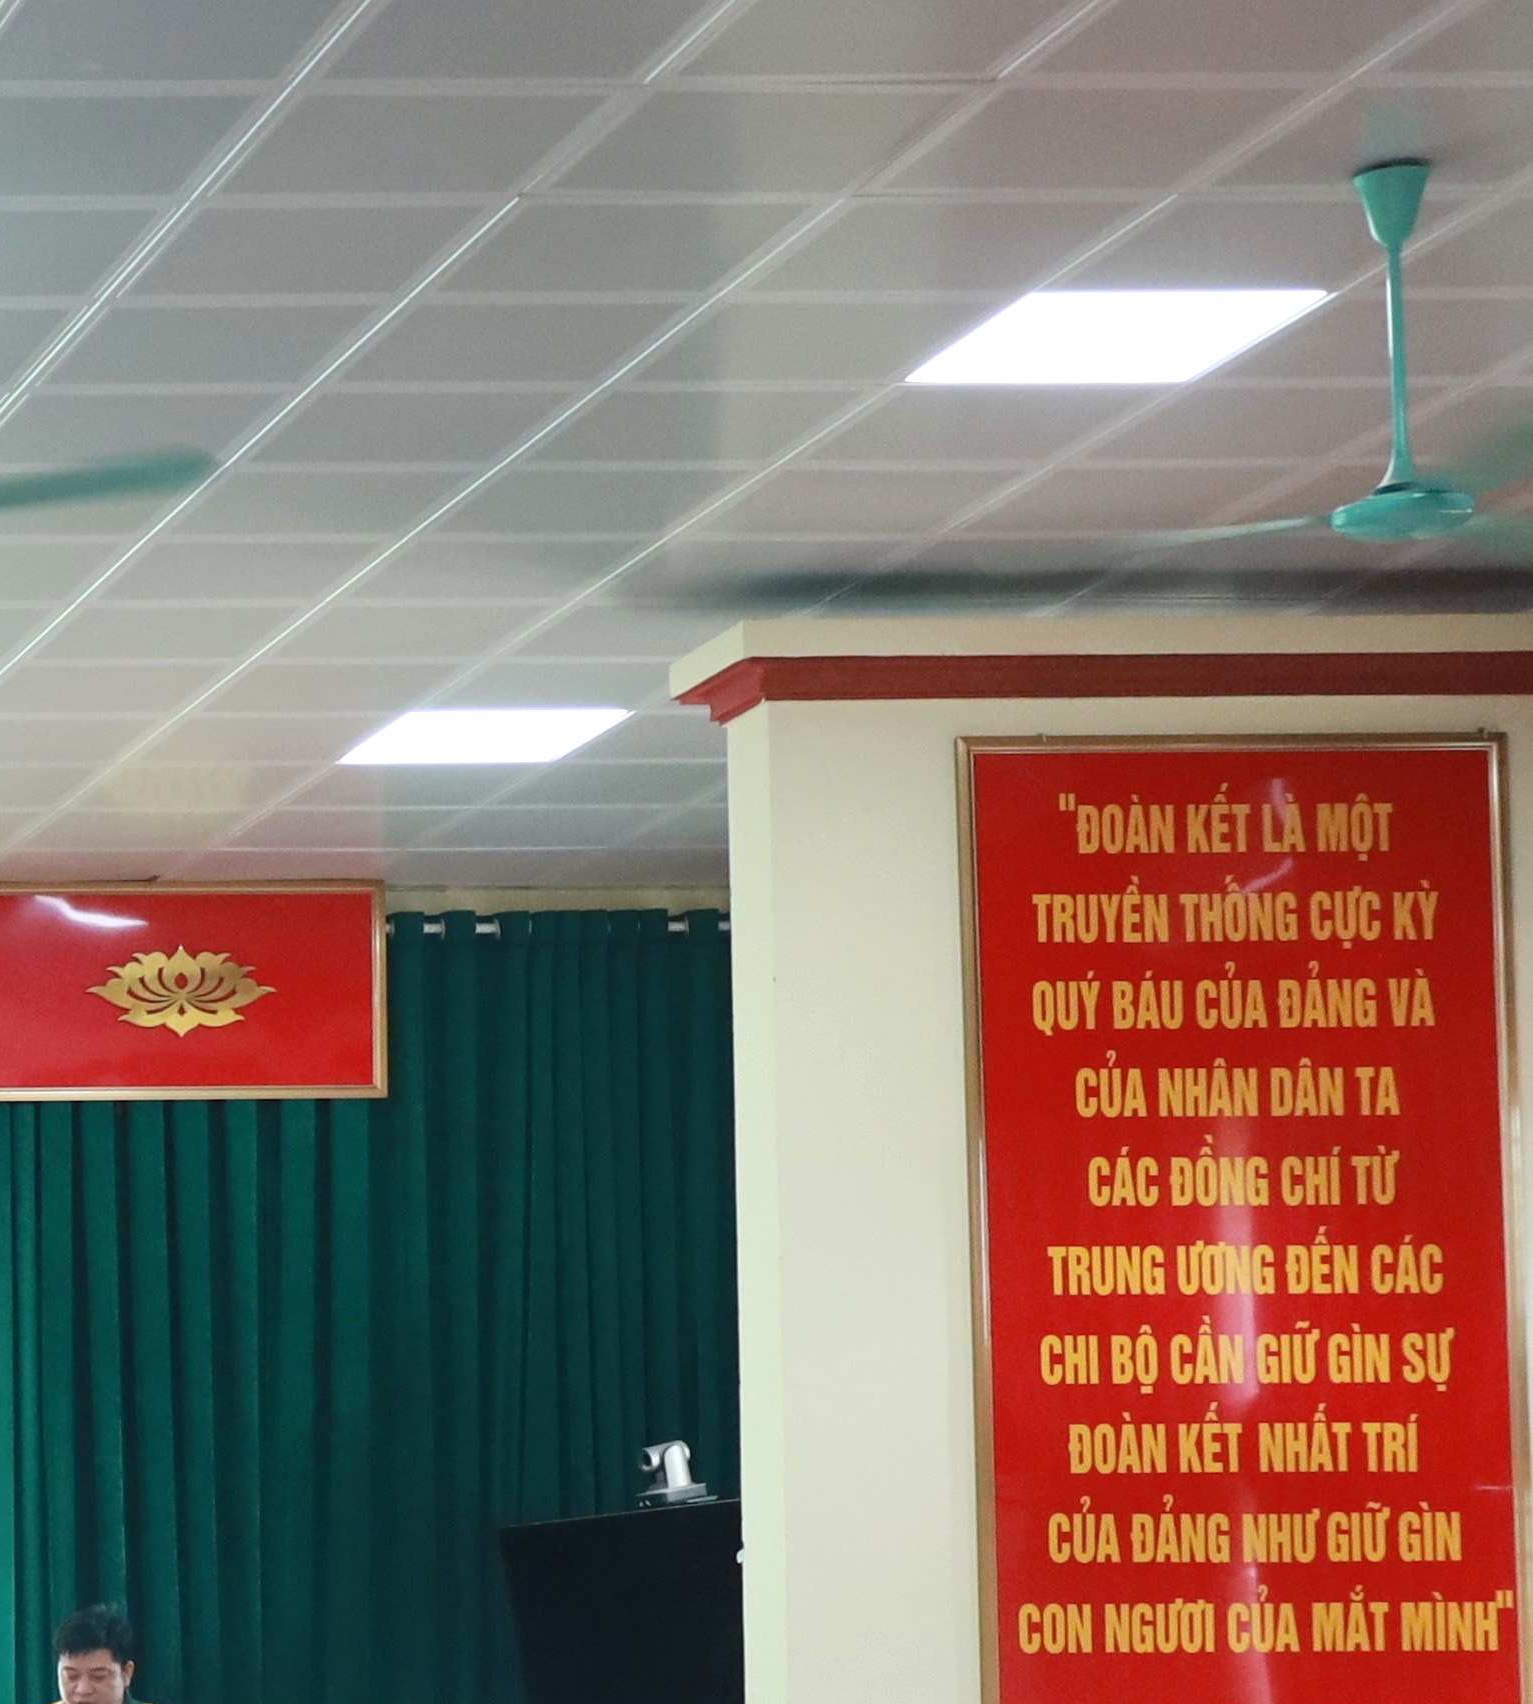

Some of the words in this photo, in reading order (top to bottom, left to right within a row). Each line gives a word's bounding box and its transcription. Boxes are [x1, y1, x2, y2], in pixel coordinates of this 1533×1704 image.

[1059, 793, 1174, 854] "ĐOÀN
[1187, 782, 1252, 854] KẾT
[1263, 793, 1306, 853] LÀ
[1317, 792, 1393, 861] MỘT
[1032, 875, 1170, 943] TRUYỀN
[1180, 875, 1298, 943] THỐNG
[1309, 886, 1381, 949] CỰC
[1393, 880, 1438, 941] KỲ
[1032, 970, 1100, 1036] QUÝ
[1112, 970, 1184, 1030] BÁU
[1195, 961, 1268, 1029] CỦA
[1278, 960, 1377, 1028] ĐẢNG
[1389, 968, 1436, 1027] VÀ
[1075, 1049, 1147, 1118] CỦA
[1158, 1057, 1258, 1117] NHÂN
[1270, 1057, 1344, 1117] DÂN
[1356, 1066, 1400, 1116] TA
[1088, 1146, 1159, 1206] CÁC
[1170, 1134, 1269, 1206] ĐỒNG
[1281, 1146, 1342, 1205] CHÍ
[1351, 1145, 1400, 1205] TỪ
[1048, 1245, 1165, 1296] TRUNG
[1177, 1240, 1275, 1295] ƯƠNG
[1286, 1226, 1358, 1294] ĐẾN
[1371, 1234, 1444, 1294] CÁC
[1040, 1335, 1099, 1384] CHI
[1111, 1325, 1158, 1394] BỘ
[1170, 1315, 1245, 1384] CẦN
[1256, 1320, 1320, 1384] GIỮ
[1328, 1323, 1391, 1384] GÌN
[1402, 1327, 1455, 1392] SỰ
[1068, 1412, 1167, 1473] ĐOÀN
[1179, 1402, 1243, 1473] KẾT
[1258, 1403, 1351, 1473] NHẤT
[1362, 1414, 1419, 1473] TRÍ
[1048, 1496, 1121, 1563] CỦA
[1131, 1494, 1231, 1563] ĐẢNG
[1242, 1509, 1321, 1563] NHƯ
[1327, 1501, 1391, 1562] GIỮ
[1398, 1503, 1462, 1561] GÌN
[1018, 1603, 1093, 1654] CON
[1227, 1584, 1300, 1653] CỦA
[1312, 1584, 1389, 1652] MẮT
[1402, 1589, 1514, 1652] MÌNH"
